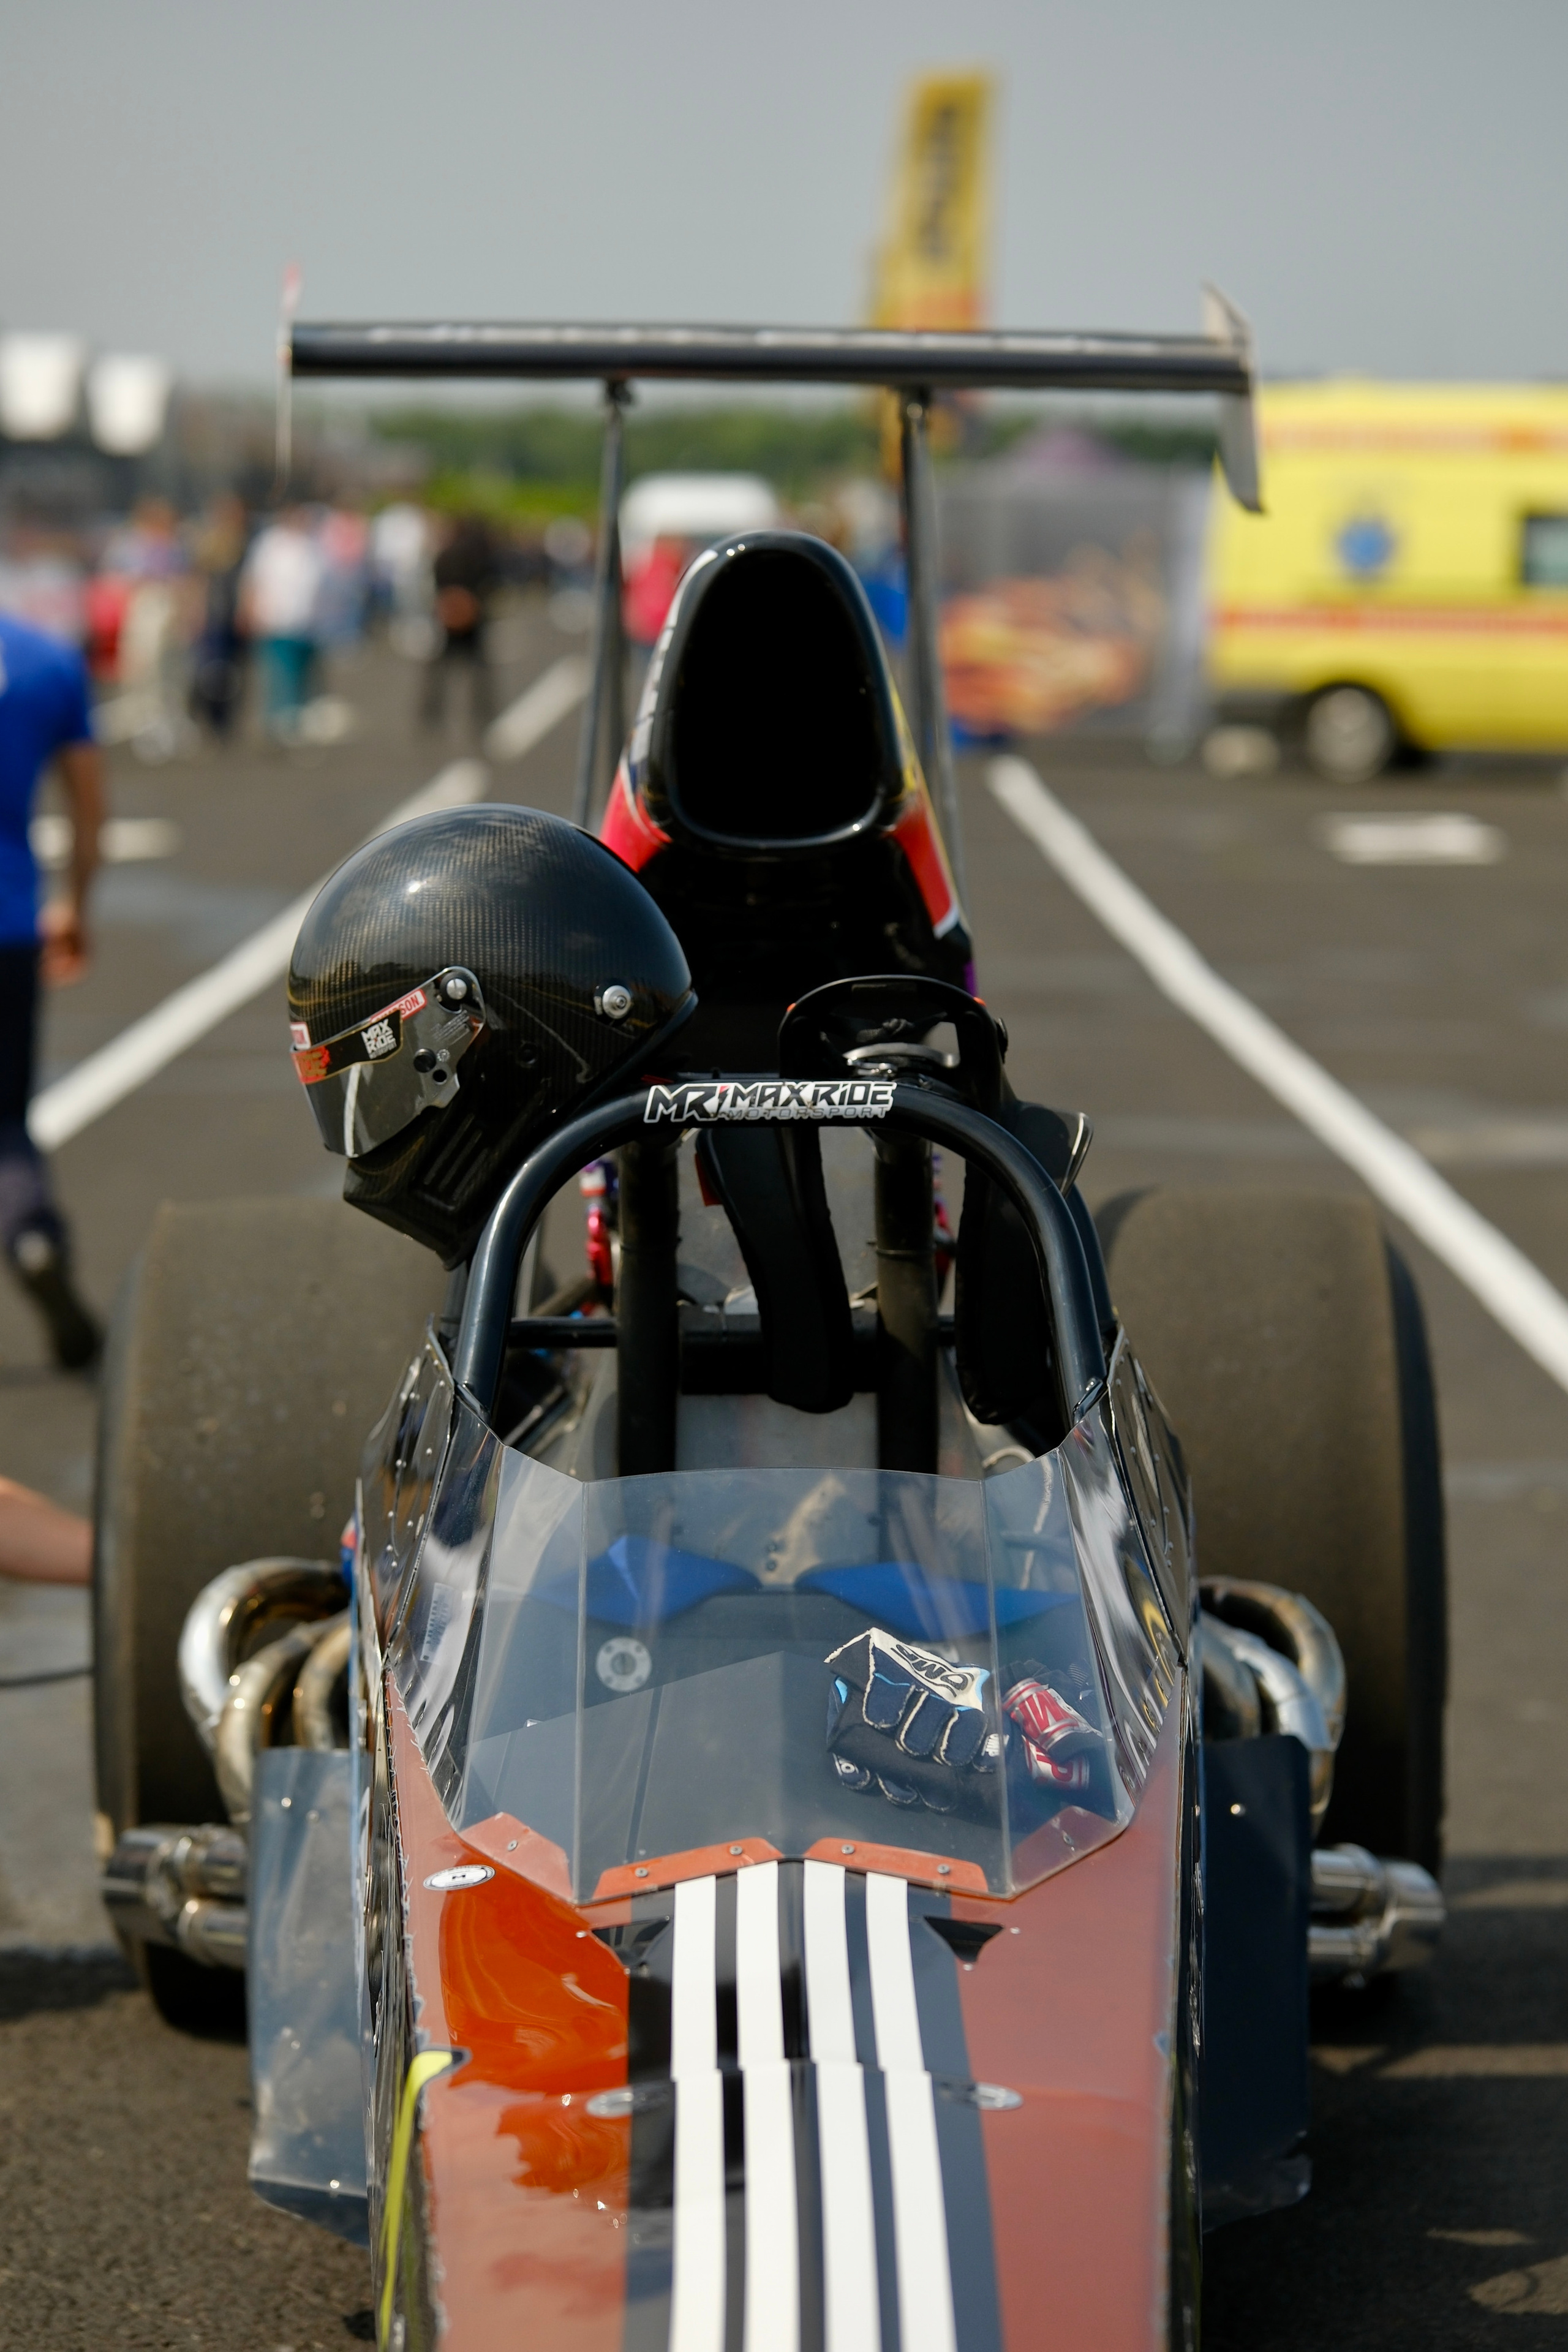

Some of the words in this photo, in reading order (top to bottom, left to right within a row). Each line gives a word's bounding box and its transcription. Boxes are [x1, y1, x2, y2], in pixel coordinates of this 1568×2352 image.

[361, 1019, 393, 1043] MAX
[366, 1030, 396, 1054] RIDE
[726, 1106, 888, 1120] MOTORSPORT
